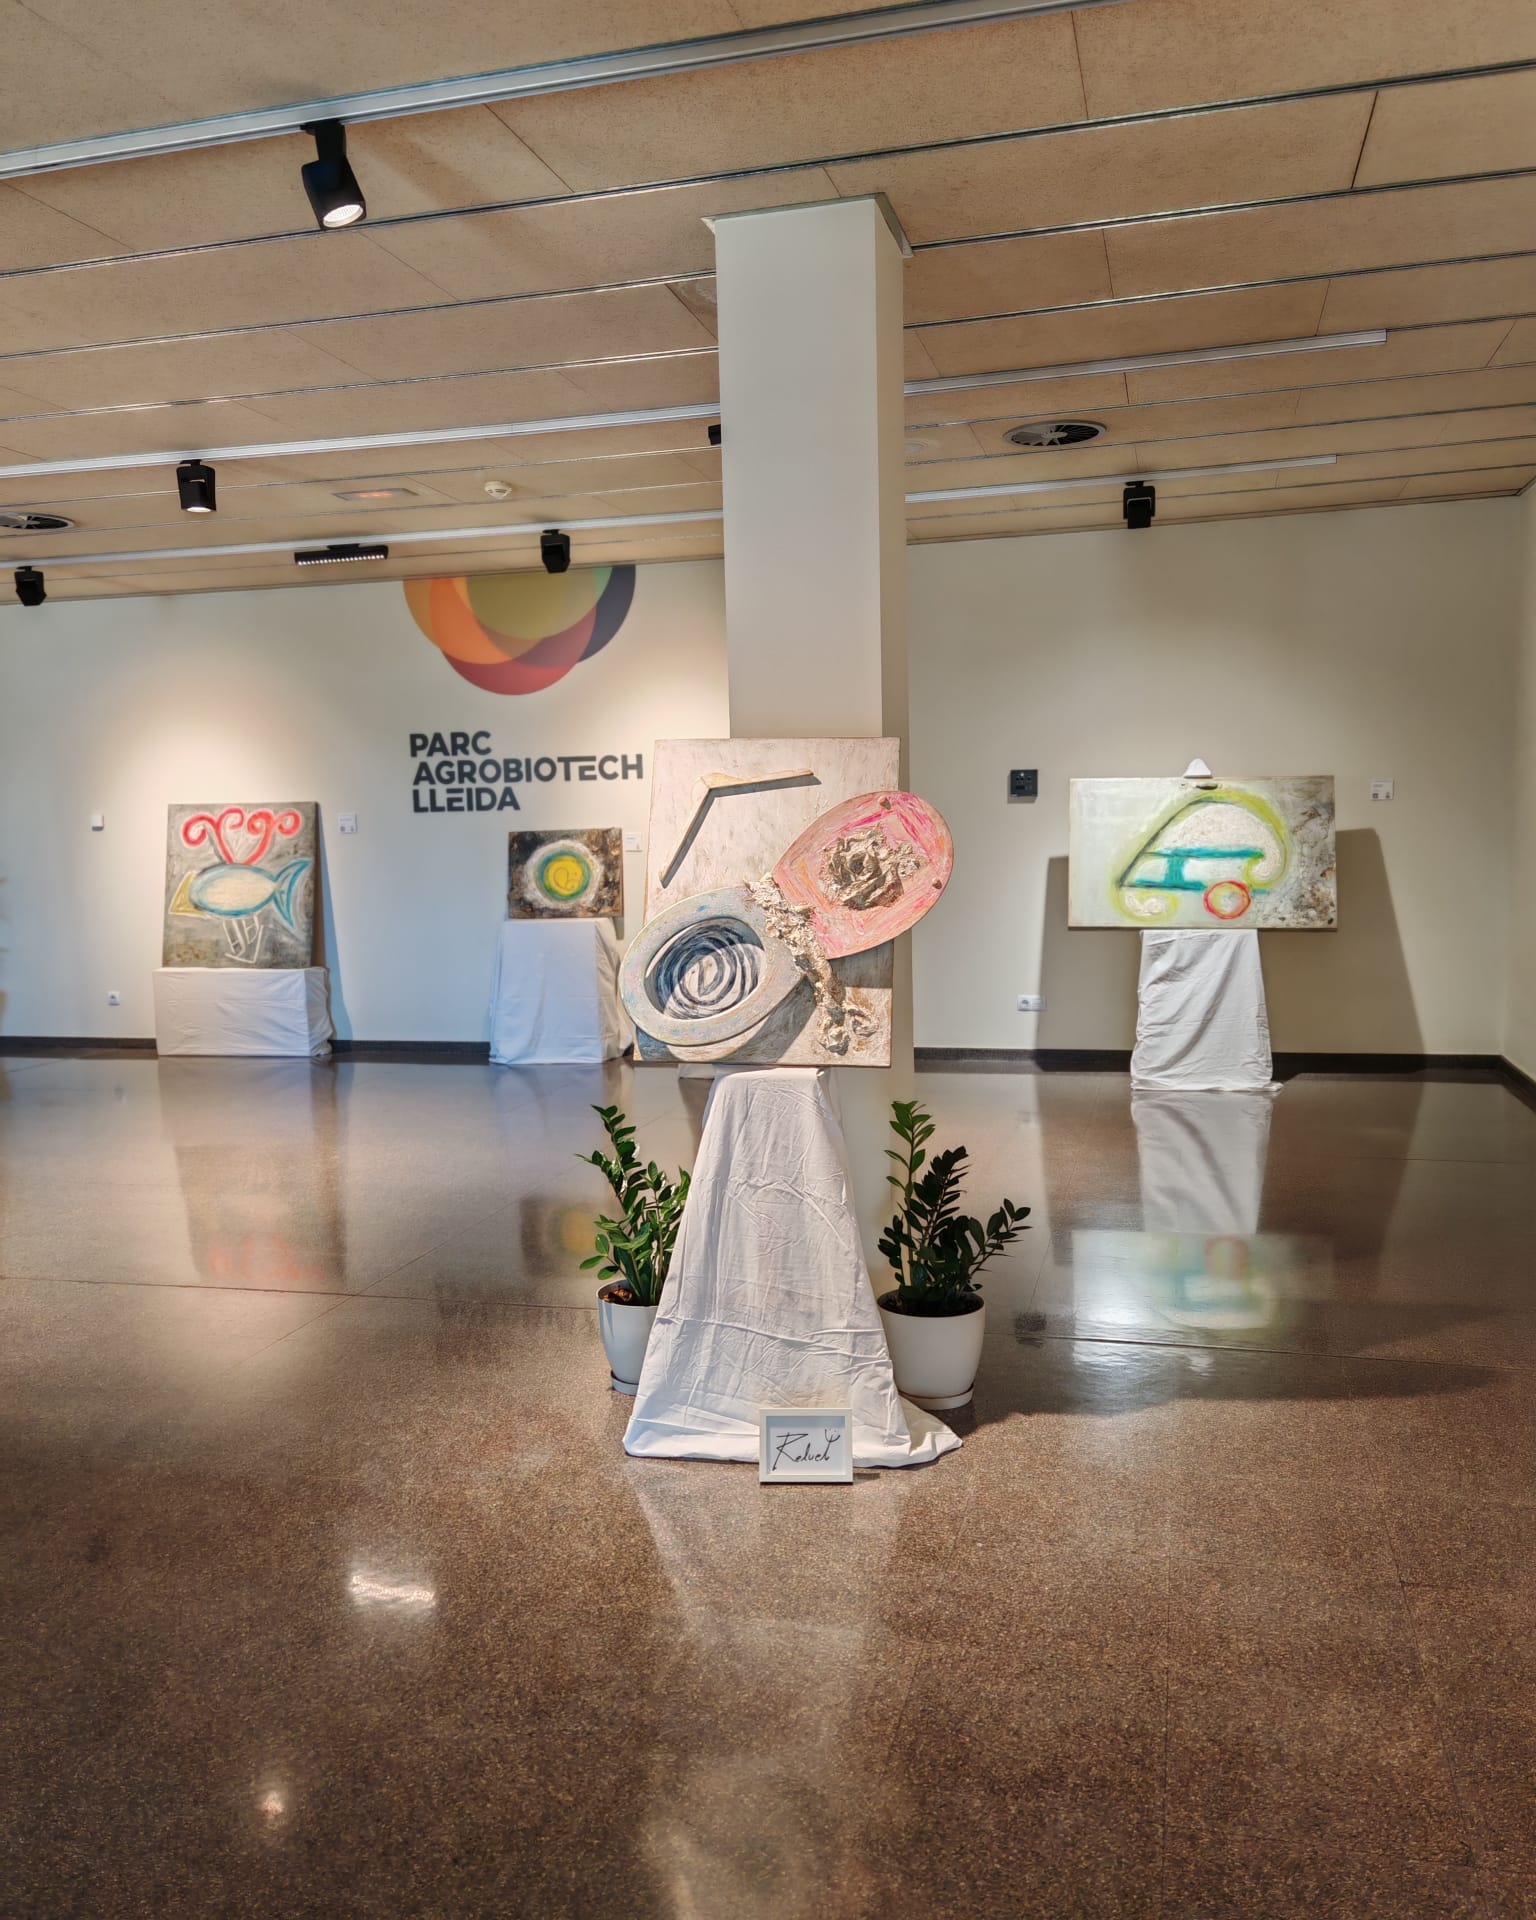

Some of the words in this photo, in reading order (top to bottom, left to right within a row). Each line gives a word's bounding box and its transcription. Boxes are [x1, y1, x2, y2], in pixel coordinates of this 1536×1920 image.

[409, 730, 492, 757] PARC
[412, 753, 643, 785] AGROBIOTECH
[412, 786, 521, 813] LLEIDA
